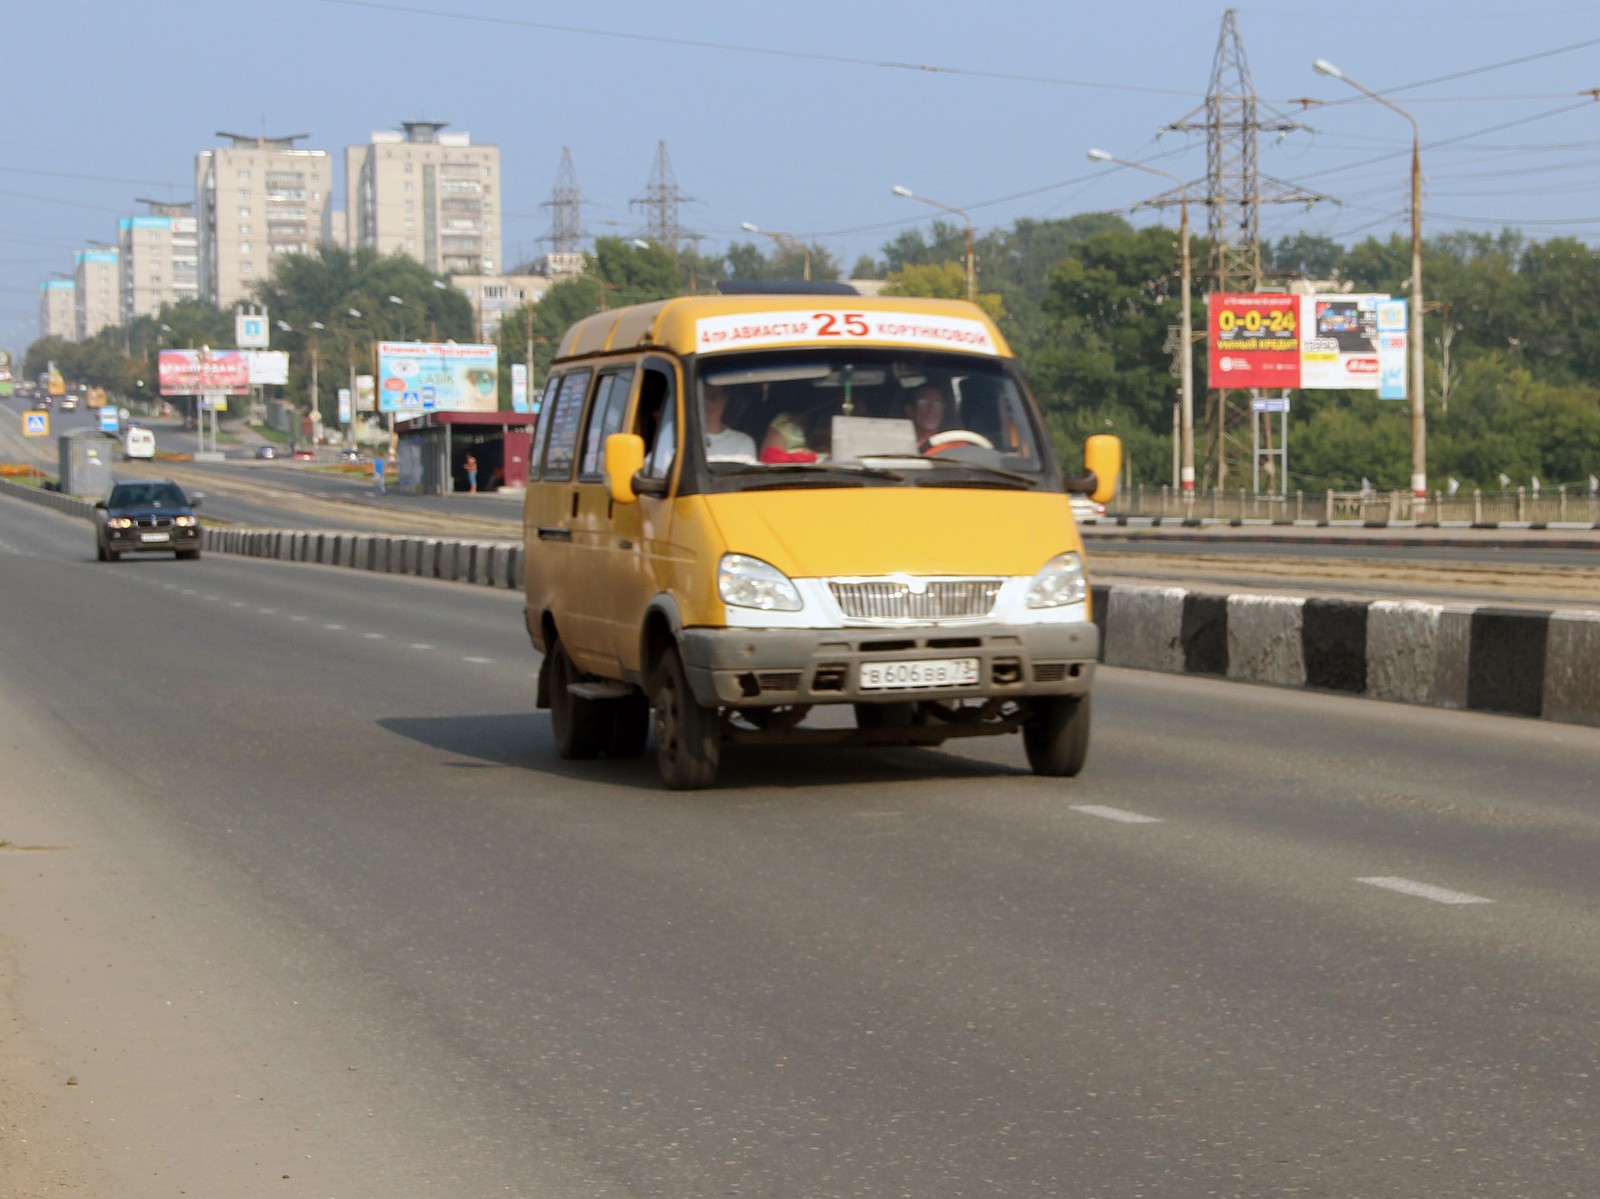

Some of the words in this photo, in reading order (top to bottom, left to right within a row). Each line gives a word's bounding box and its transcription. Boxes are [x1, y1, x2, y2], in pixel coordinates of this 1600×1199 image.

[812, 313, 869, 337] 25
[1218, 309, 1297, 332] 0-0-24
[1259, 338, 1298, 351] КРЕДИТ
